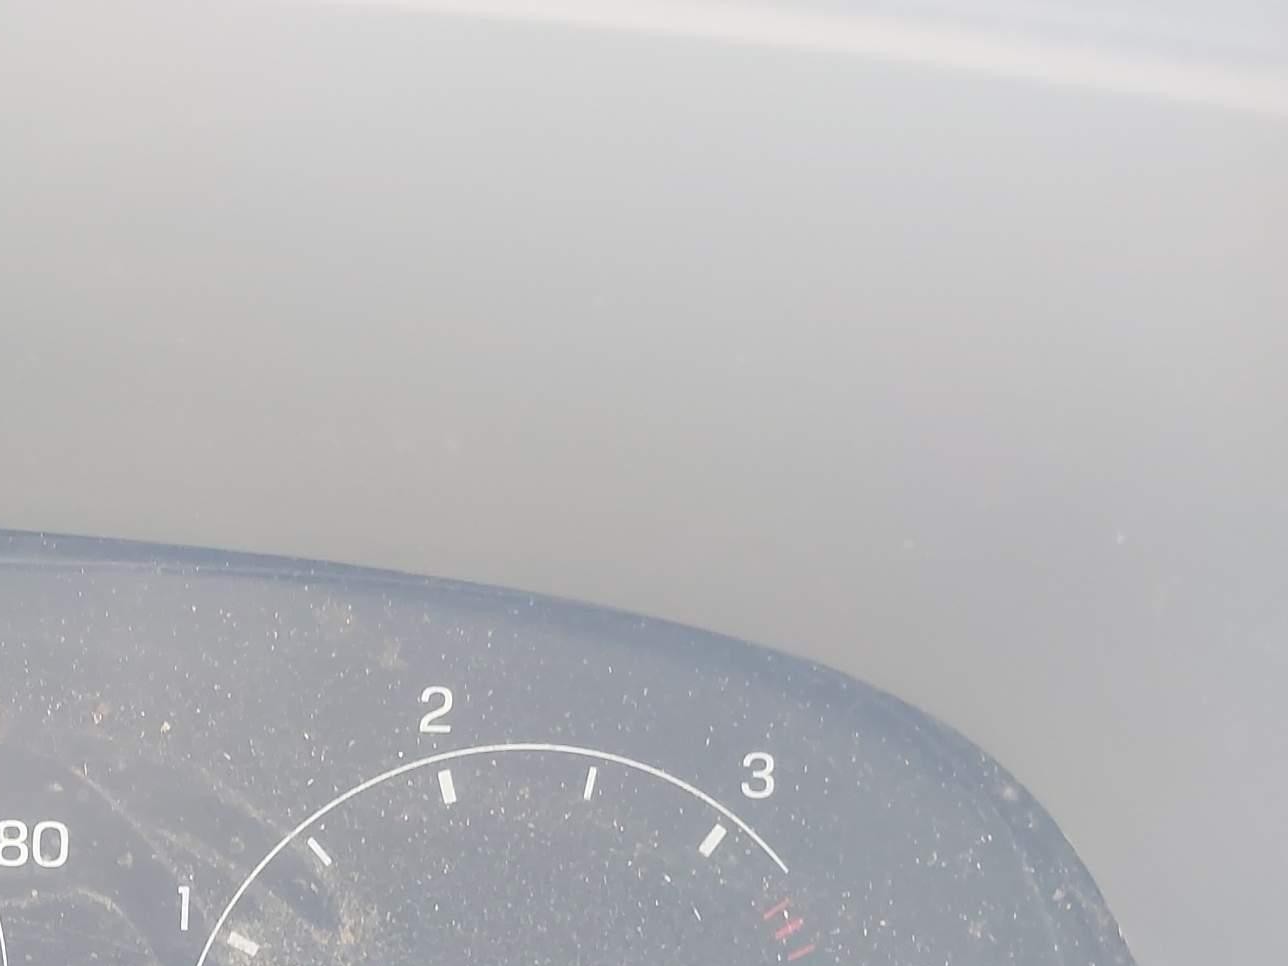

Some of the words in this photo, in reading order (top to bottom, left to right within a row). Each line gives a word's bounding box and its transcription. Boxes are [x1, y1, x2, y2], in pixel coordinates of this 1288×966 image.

[420, 687, 451, 733] 2
[742, 752, 775, 798] 3
[178, 885, 189, 930] 1
